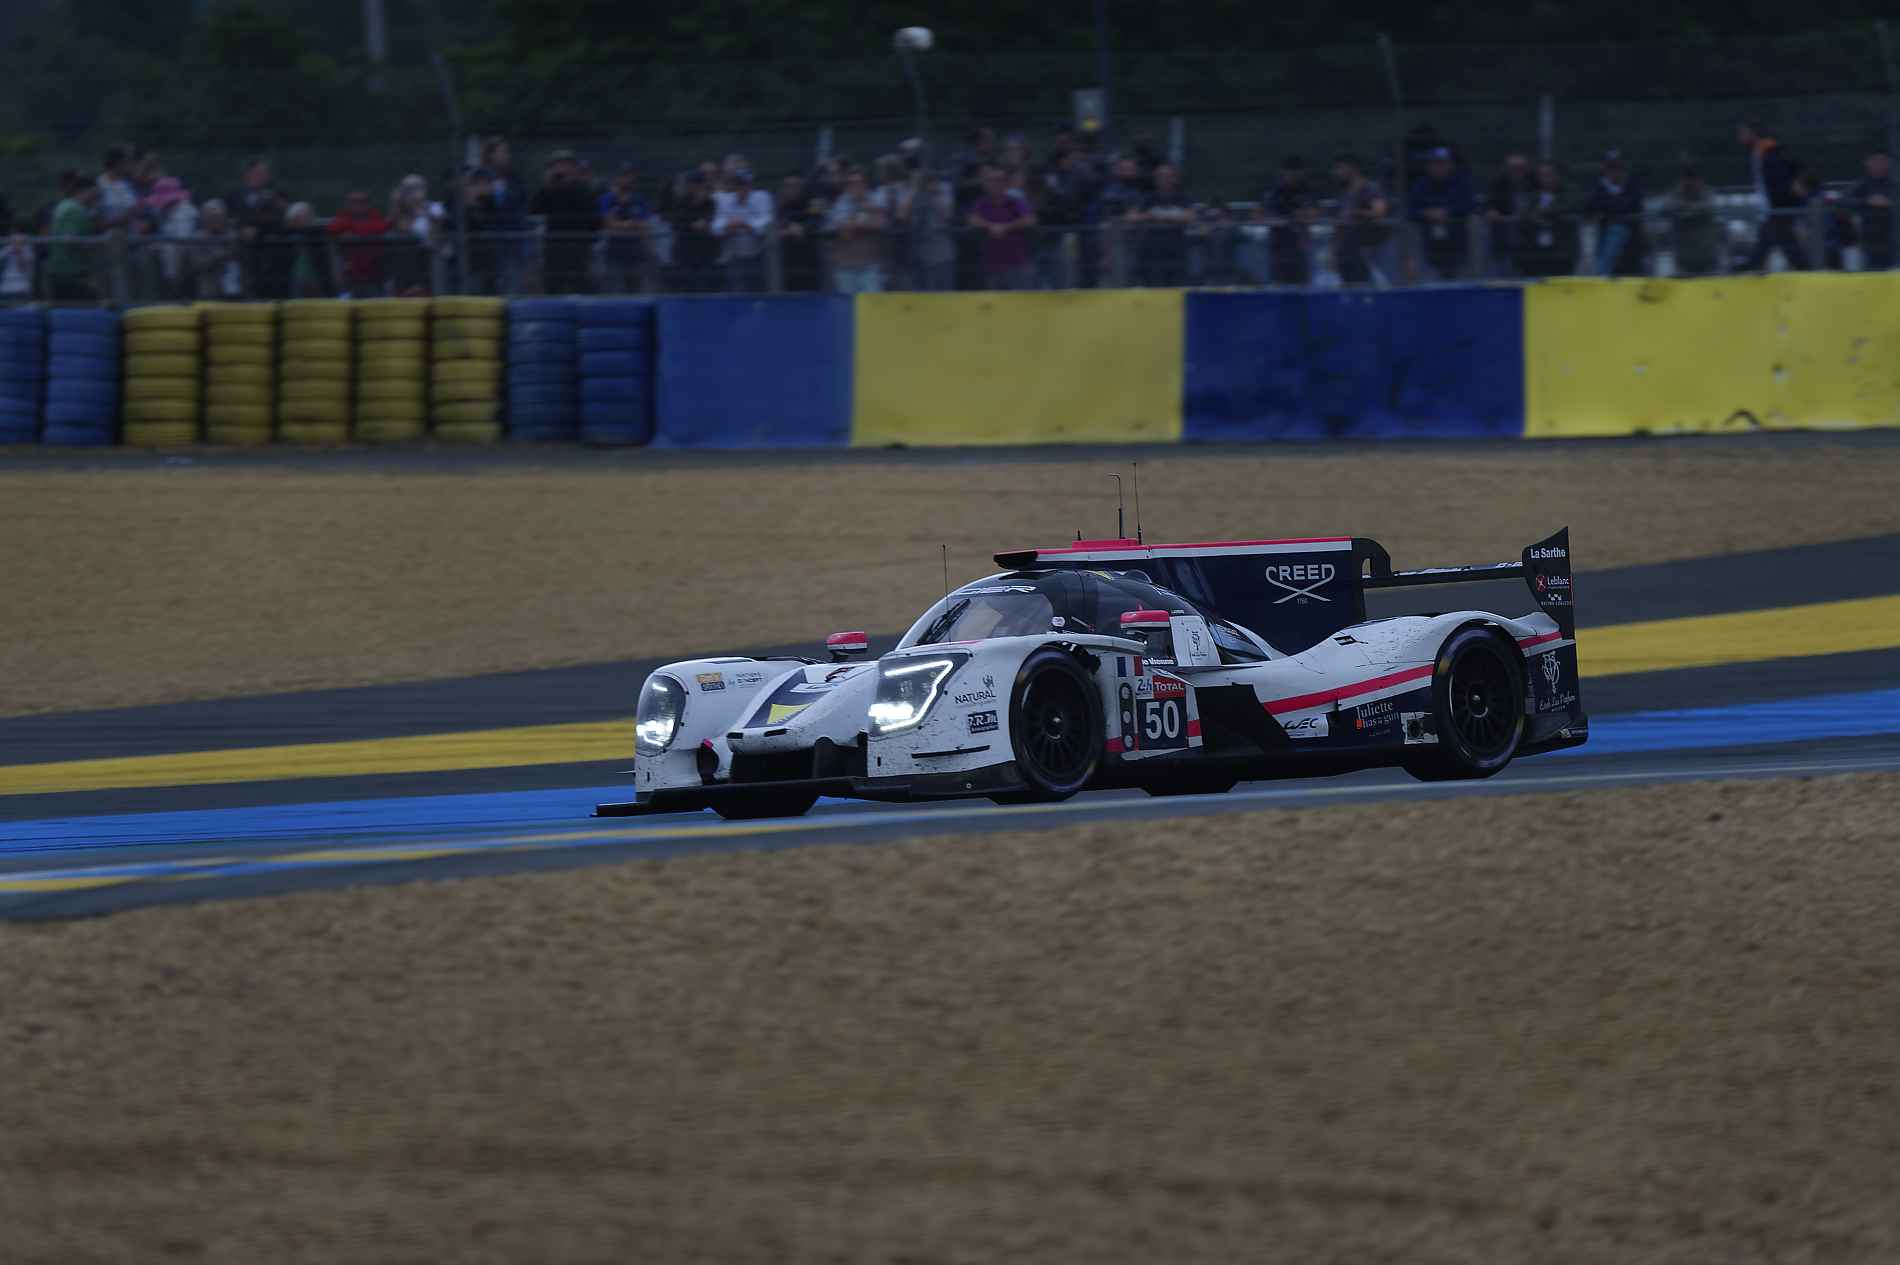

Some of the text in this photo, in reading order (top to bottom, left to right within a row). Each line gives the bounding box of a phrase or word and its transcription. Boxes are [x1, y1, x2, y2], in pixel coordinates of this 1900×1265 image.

[1530, 547, 1567, 559] La Sarthe
[1266, 564, 1335, 582] CREED
[1154, 682, 1185, 693] TOTAL
[955, 690, 997, 704] NATURAL
[1356, 702, 1394, 720] Juliette
[1145, 700, 1180, 740] 50
[1284, 717, 1319, 730] WEC
